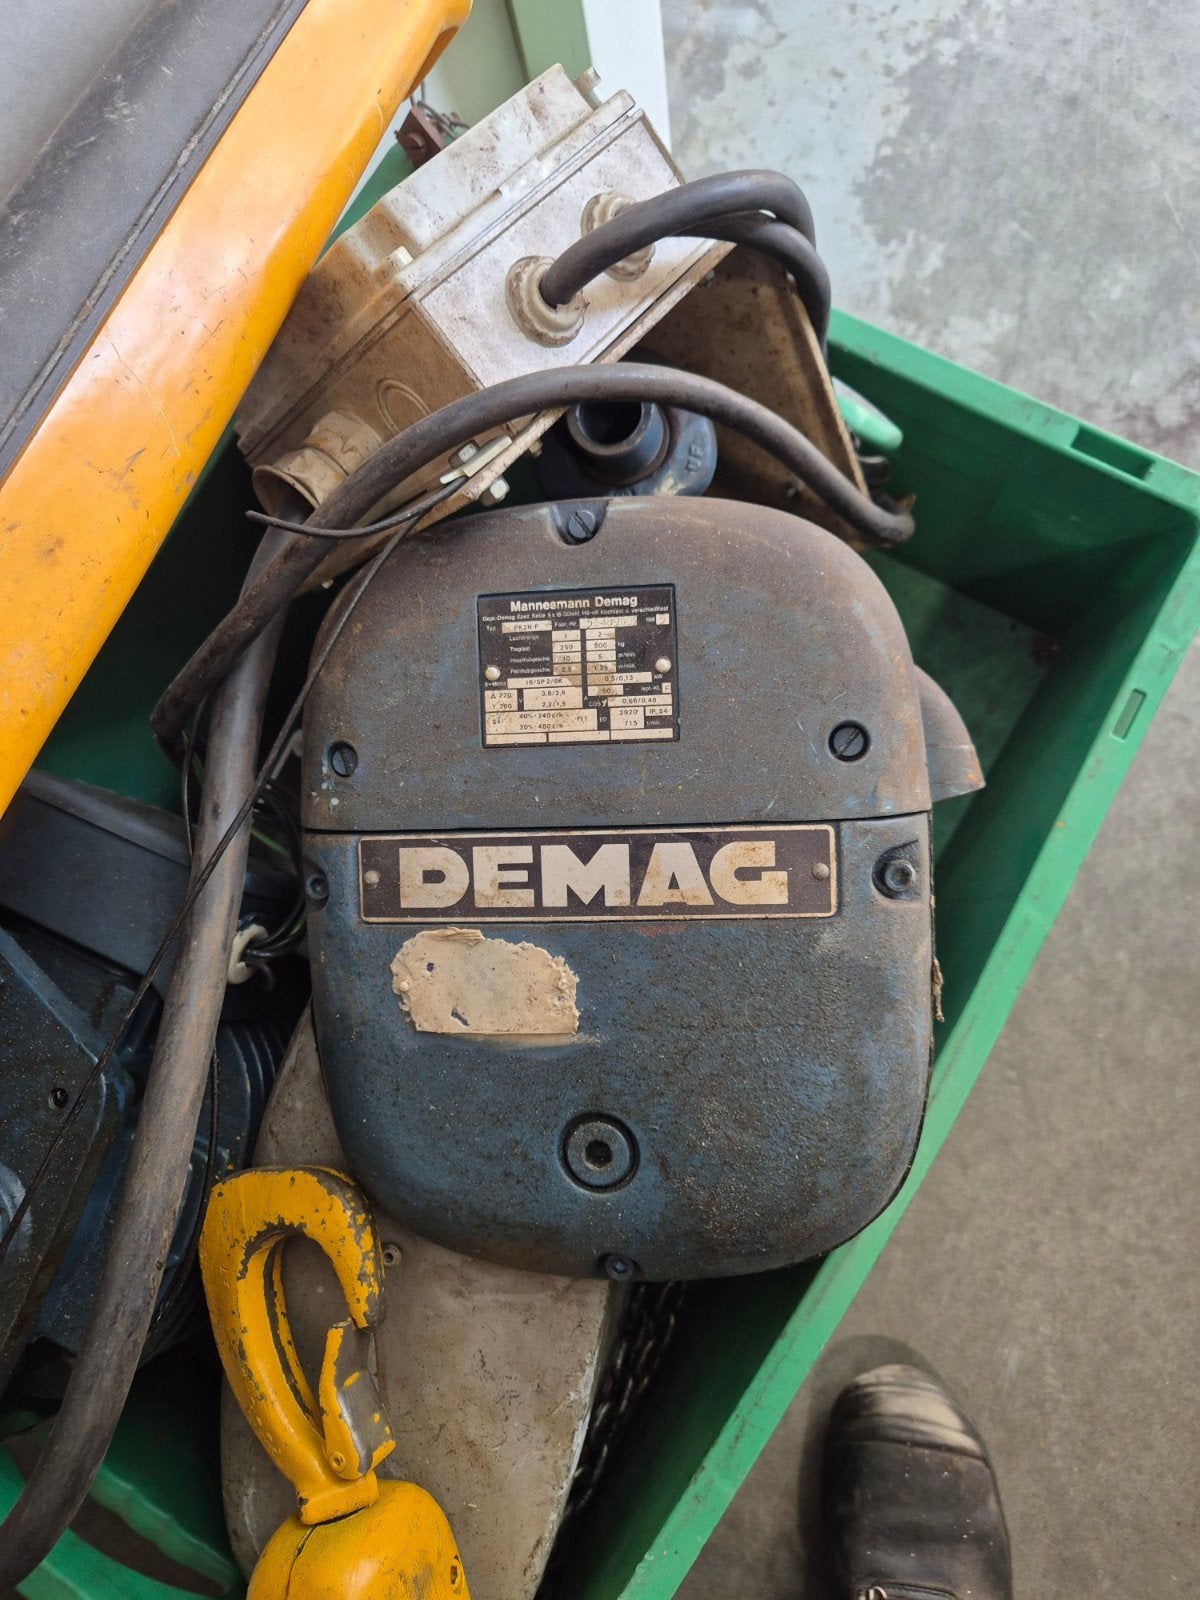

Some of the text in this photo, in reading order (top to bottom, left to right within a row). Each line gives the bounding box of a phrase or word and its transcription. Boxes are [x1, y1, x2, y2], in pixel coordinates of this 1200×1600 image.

[511, 596, 638, 612] Mannesmann Demag
[399, 840, 789, 909] DEMAG
